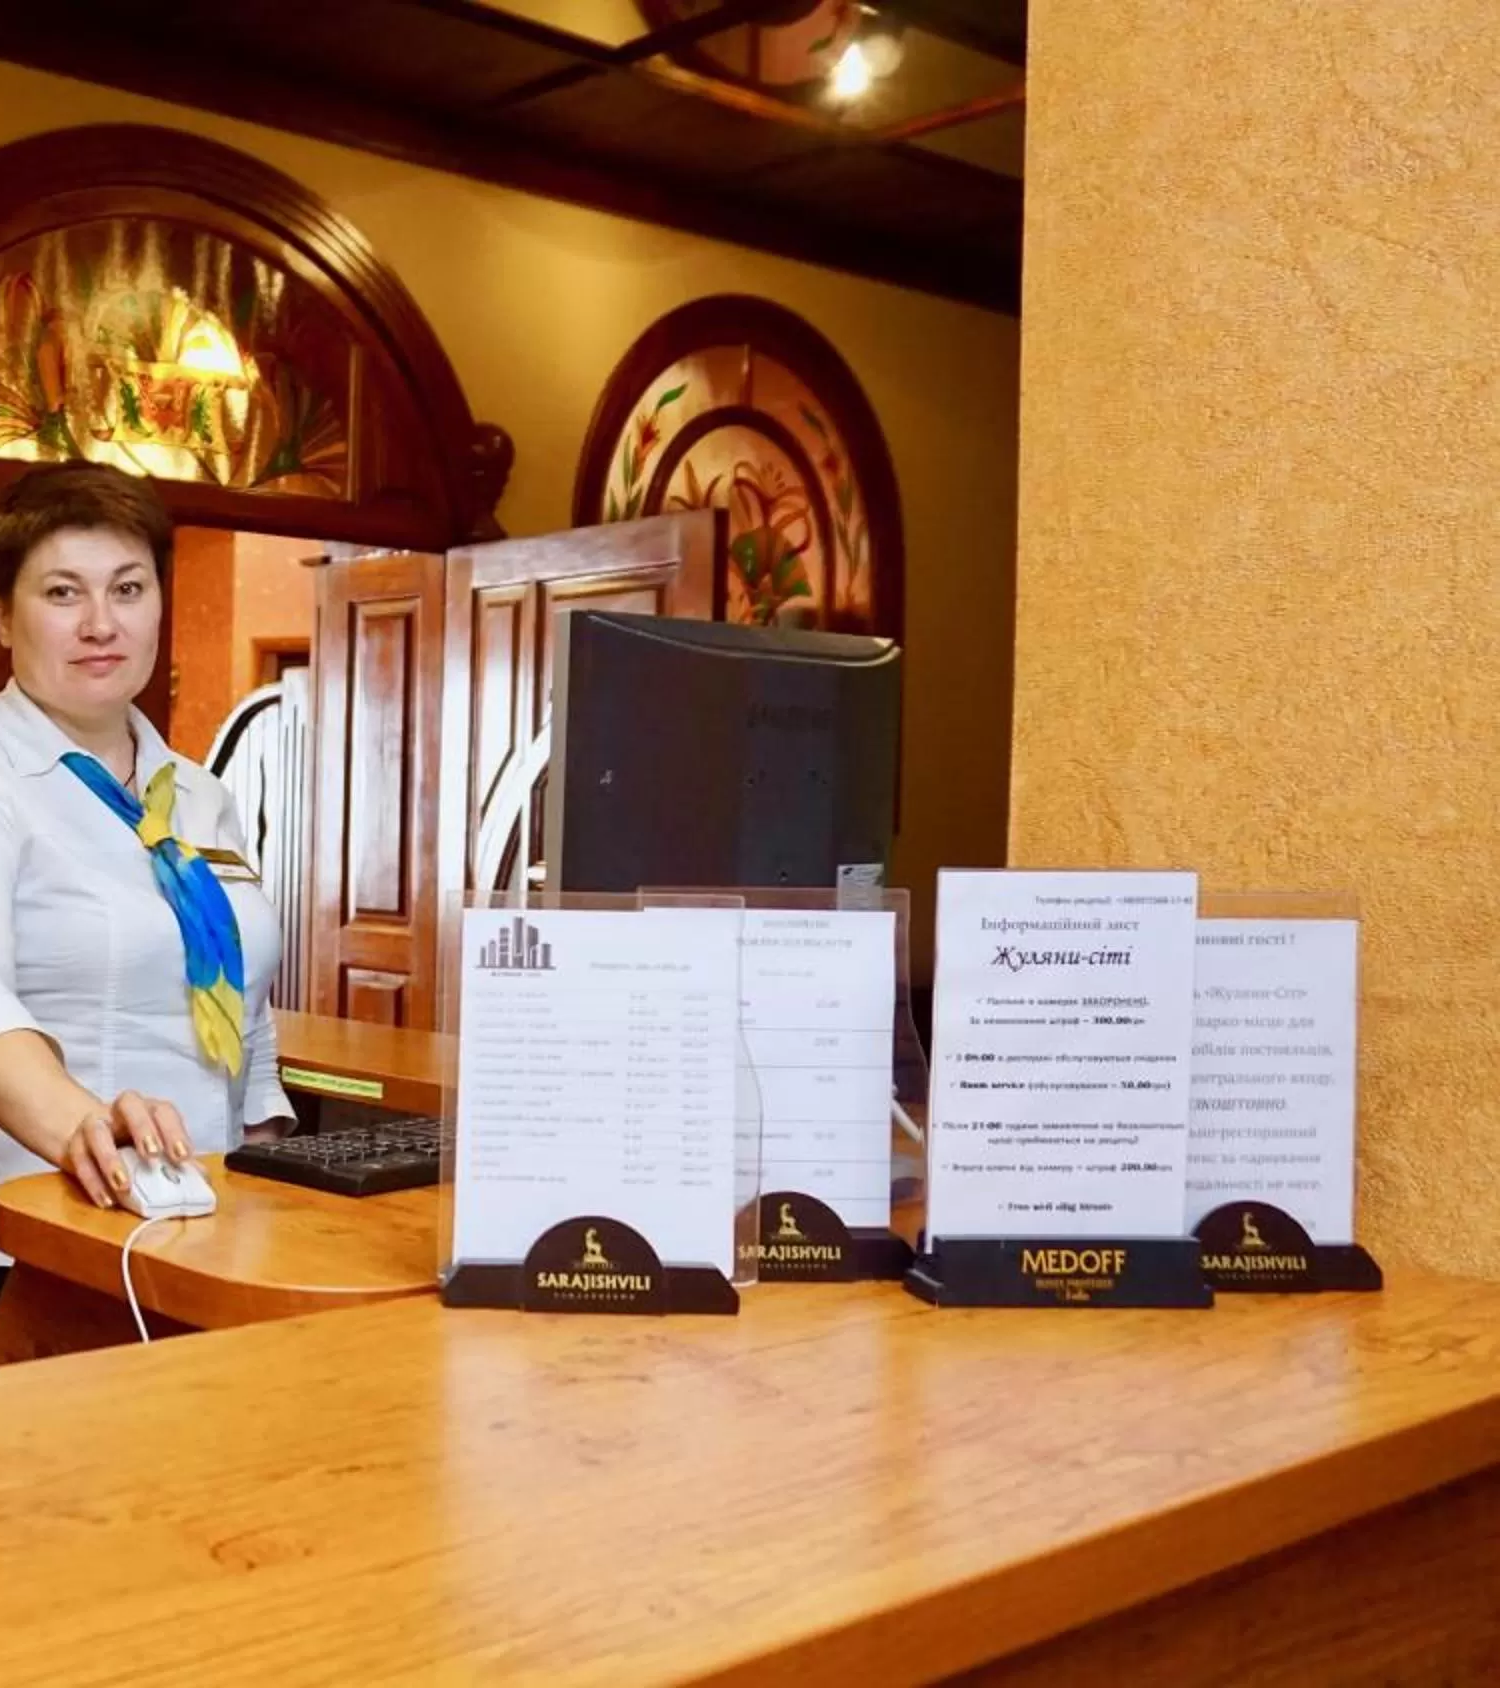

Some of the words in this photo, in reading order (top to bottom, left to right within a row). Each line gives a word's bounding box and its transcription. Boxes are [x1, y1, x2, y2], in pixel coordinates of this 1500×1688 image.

[980, 917, 1101, 935] Інформаційний
[1105, 919, 1140, 931] лист
[990, 944, 1135, 973] Жуляни-сіті
[1190, 1071, 1287, 1088] ентрального
[738, 1244, 842, 1263] SARAJISHVILI
[1021, 1249, 1127, 1275] MEDOFF
[1201, 1254, 1308, 1273] SARAJISHVILI
[537, 1271, 651, 1292] SARAJISHVILI
